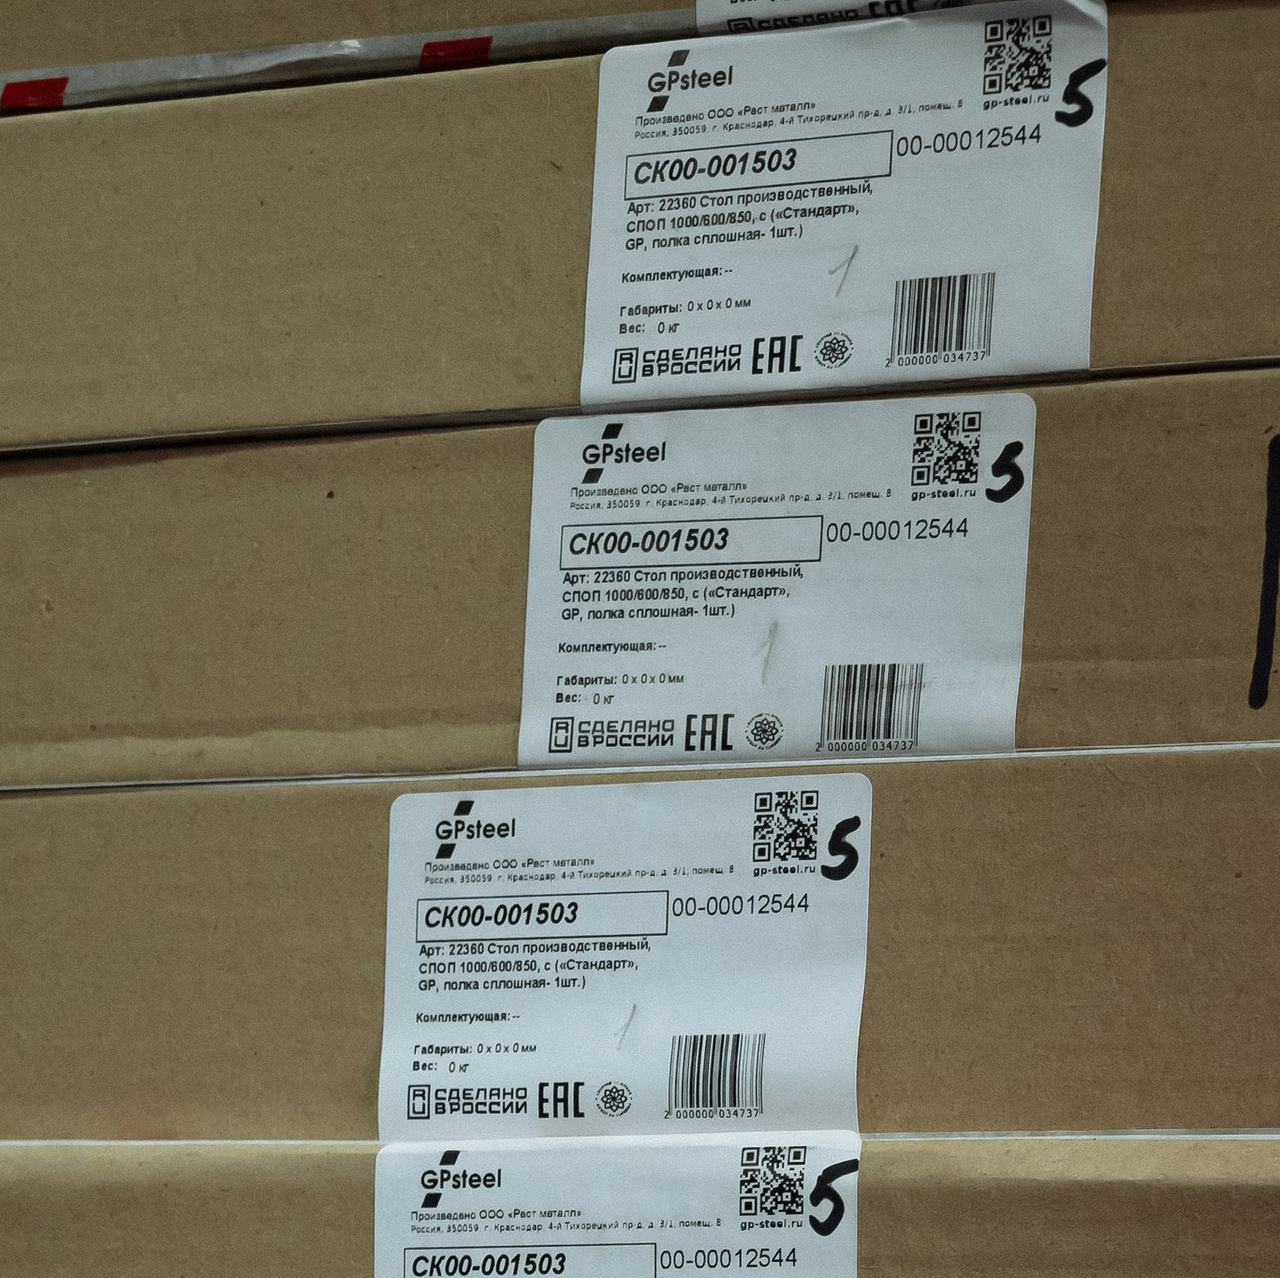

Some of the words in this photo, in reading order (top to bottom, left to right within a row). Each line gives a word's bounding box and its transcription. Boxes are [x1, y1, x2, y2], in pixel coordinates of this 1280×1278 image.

[646, 66, 734, 93] GPsteel
[1055, 58, 1107, 126] 5
[982, 95, 1050, 111] gp-steel.ru
[896, 123, 1042, 157] 00-00012544
[626, 201, 655, 217] Арт:
[658, 196, 697, 212] 22360
[698, 194, 733, 208] Стол
[736, 178, 874, 207] производственный,
[625, 218, 667, 234] СПОП
[621, 266, 723, 284] Комплектующая:
[619, 303, 683, 318] Габариты:
[618, 322, 646, 335] Вес:
[641, 343, 743, 365] СДЕЛАНО
[581, 442, 667, 465] GPsteel
[985, 441, 1024, 503] 5
[910, 488, 977, 502] gp-steel.ru
[825, 517, 969, 543] 00-00012544
[562, 571, 590, 587] Арт:
[593, 570, 631, 584] 22360
[632, 570, 667, 583] Стол
[669, 563, 804, 584] производственный,
[561, 590, 602, 603] СПОП
[557, 641, 657, 655] Комплектующая:
[555, 674, 618, 688] Габариты:
[577, 719, 676, 735] СДЕЛАНО
[434, 818, 516, 841] GPsteel
[821, 816, 861, 881] 5
[752, 864, 816, 877] gp-steel.ru
[672, 893, 809, 917] 00-00012544
[418, 944, 445, 959] Арт:
[448, 943, 485, 956] 22360
[486, 943, 519, 955] Стол
[522, 936, 652, 956] производственный,
[418, 962, 457, 975] СПОП
[417, 979, 440, 993] GP,
[443, 980, 480, 991] полка
[415, 1012, 511, 1025] Комплектующая:
[413, 1043, 473, 1057] Габариты:
[434, 1087, 529, 1102] СДЕЛАНО
[420, 1169, 502, 1190] GPsteel
[809, 1158, 859, 1236] 5
[740, 1219, 803, 1231] gp-steel.ru
[660, 1247, 797, 1269] 00-00012544
